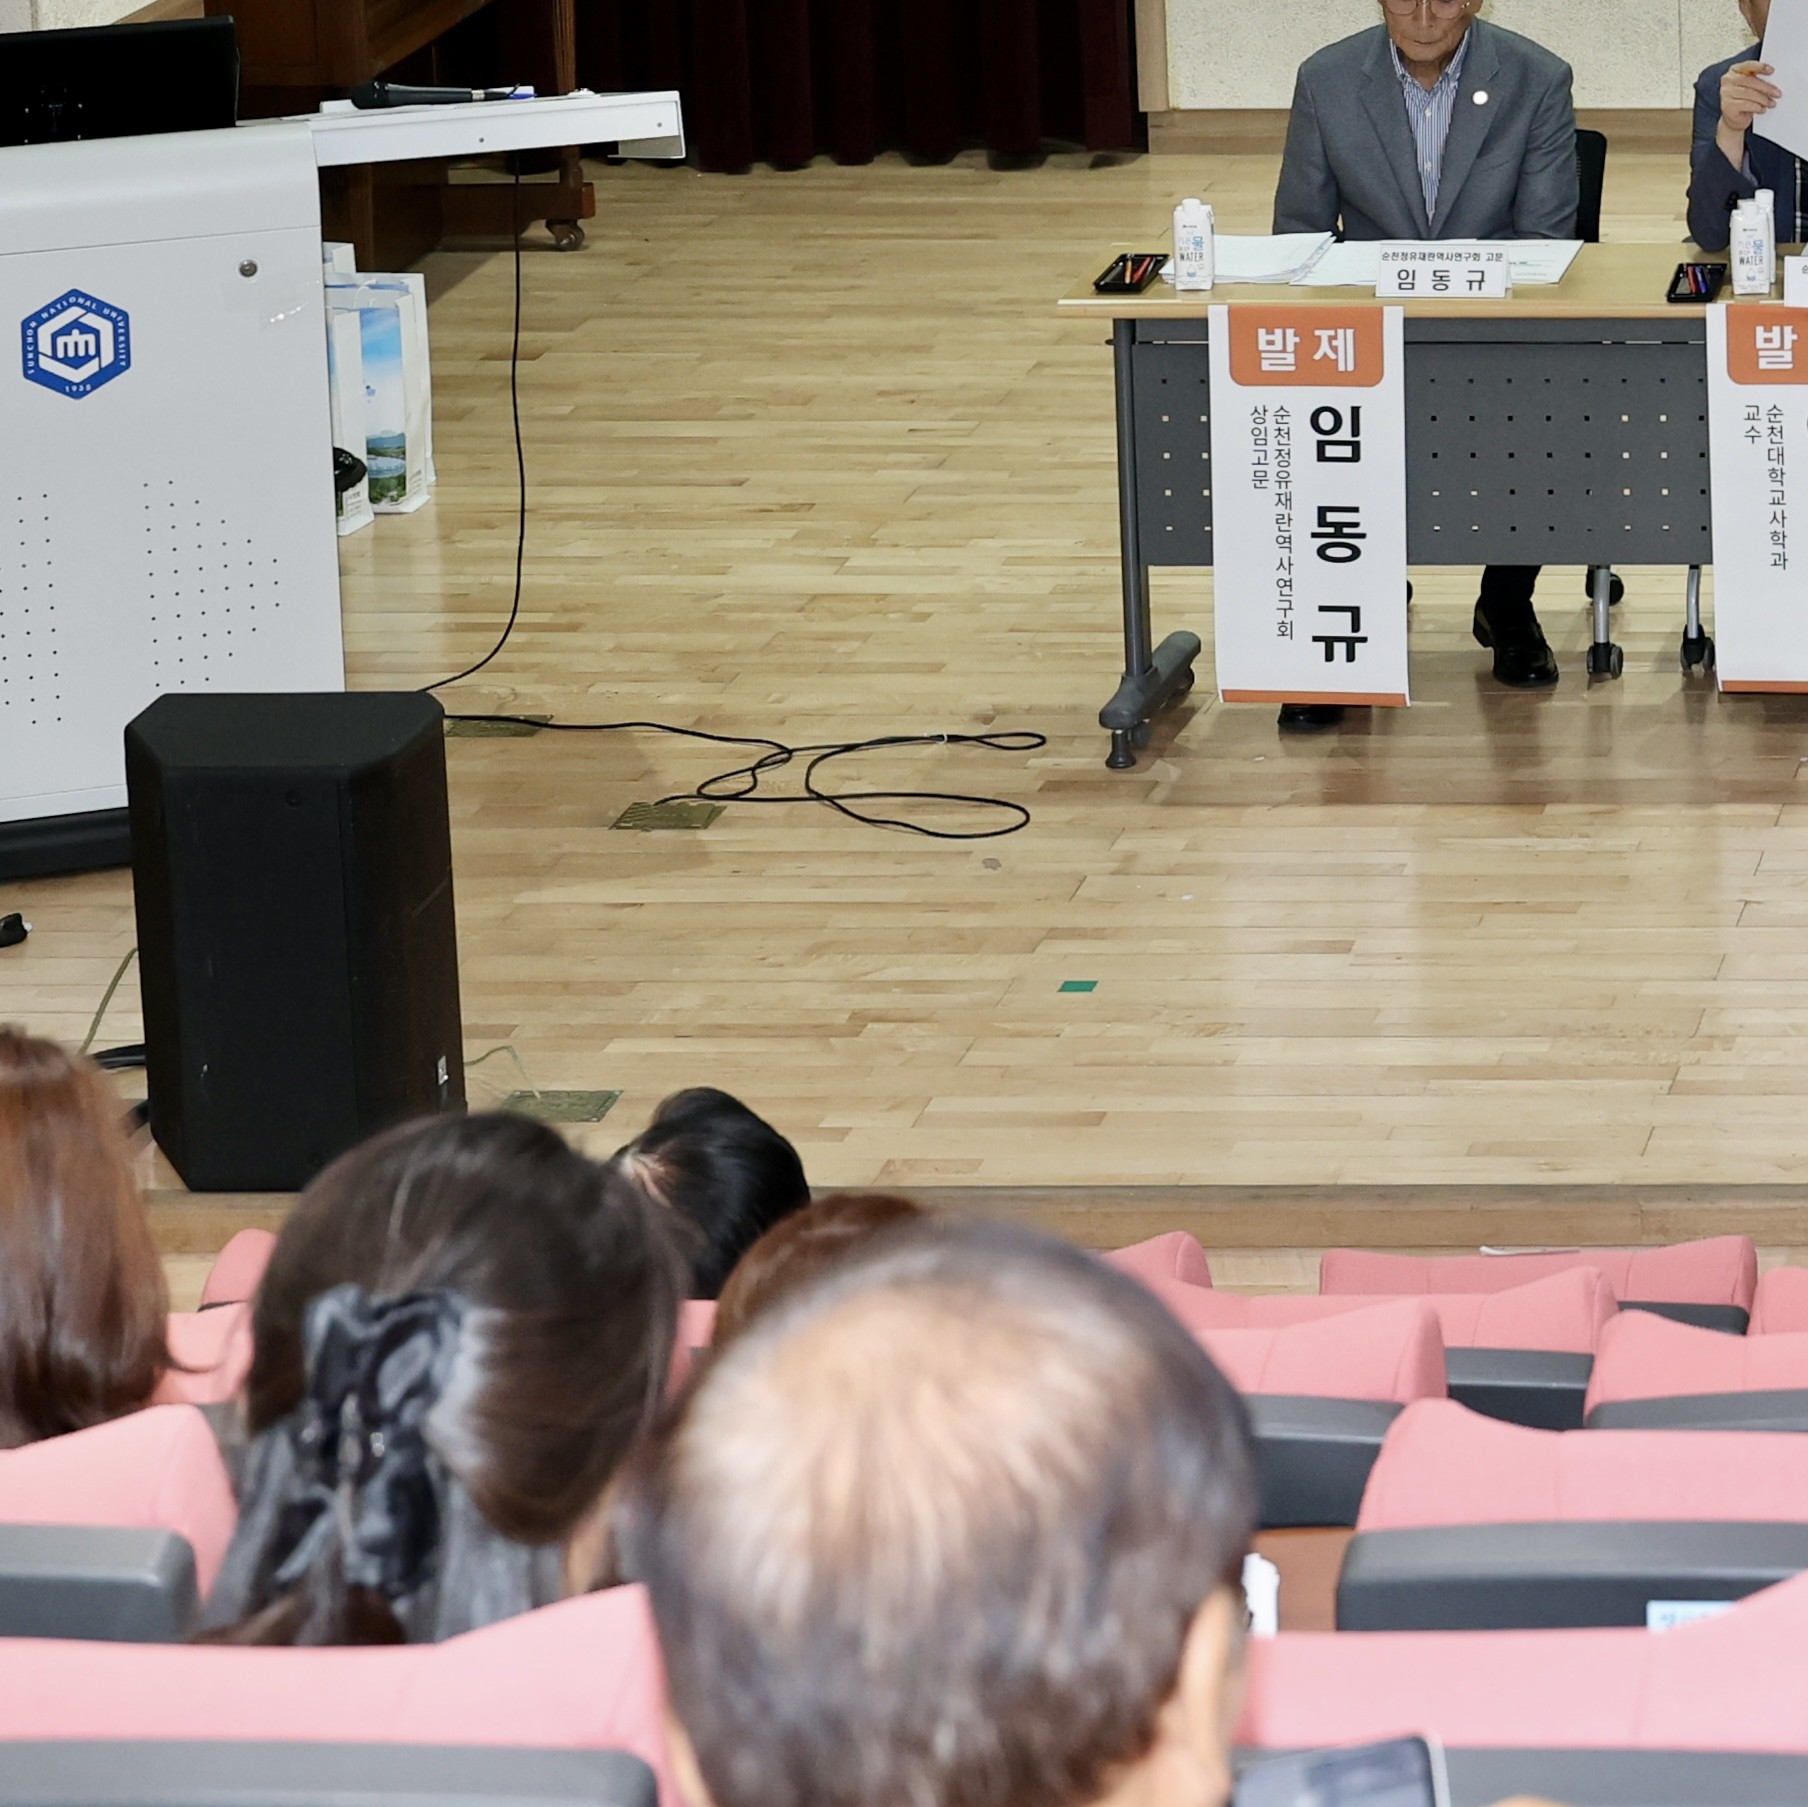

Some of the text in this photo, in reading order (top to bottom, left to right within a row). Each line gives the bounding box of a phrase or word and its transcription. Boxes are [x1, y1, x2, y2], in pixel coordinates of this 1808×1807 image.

[1179, 252, 1204, 262] WATER
[1382, 252, 1503, 262] 순천정유재란역사연구회 고문
[1739, 255, 1763, 265] WATER
[26, 296, 127, 375] SUNCHON NATIONAL UNIVERSITY
[1258, 328, 1354, 371] 발제
[65, 384, 92, 392] 1935
[1744, 405, 1762, 444] 교수
[1251, 405, 1269, 490] 상임고문
[1273, 405, 1294, 640] 순천정유재란역사연구회
